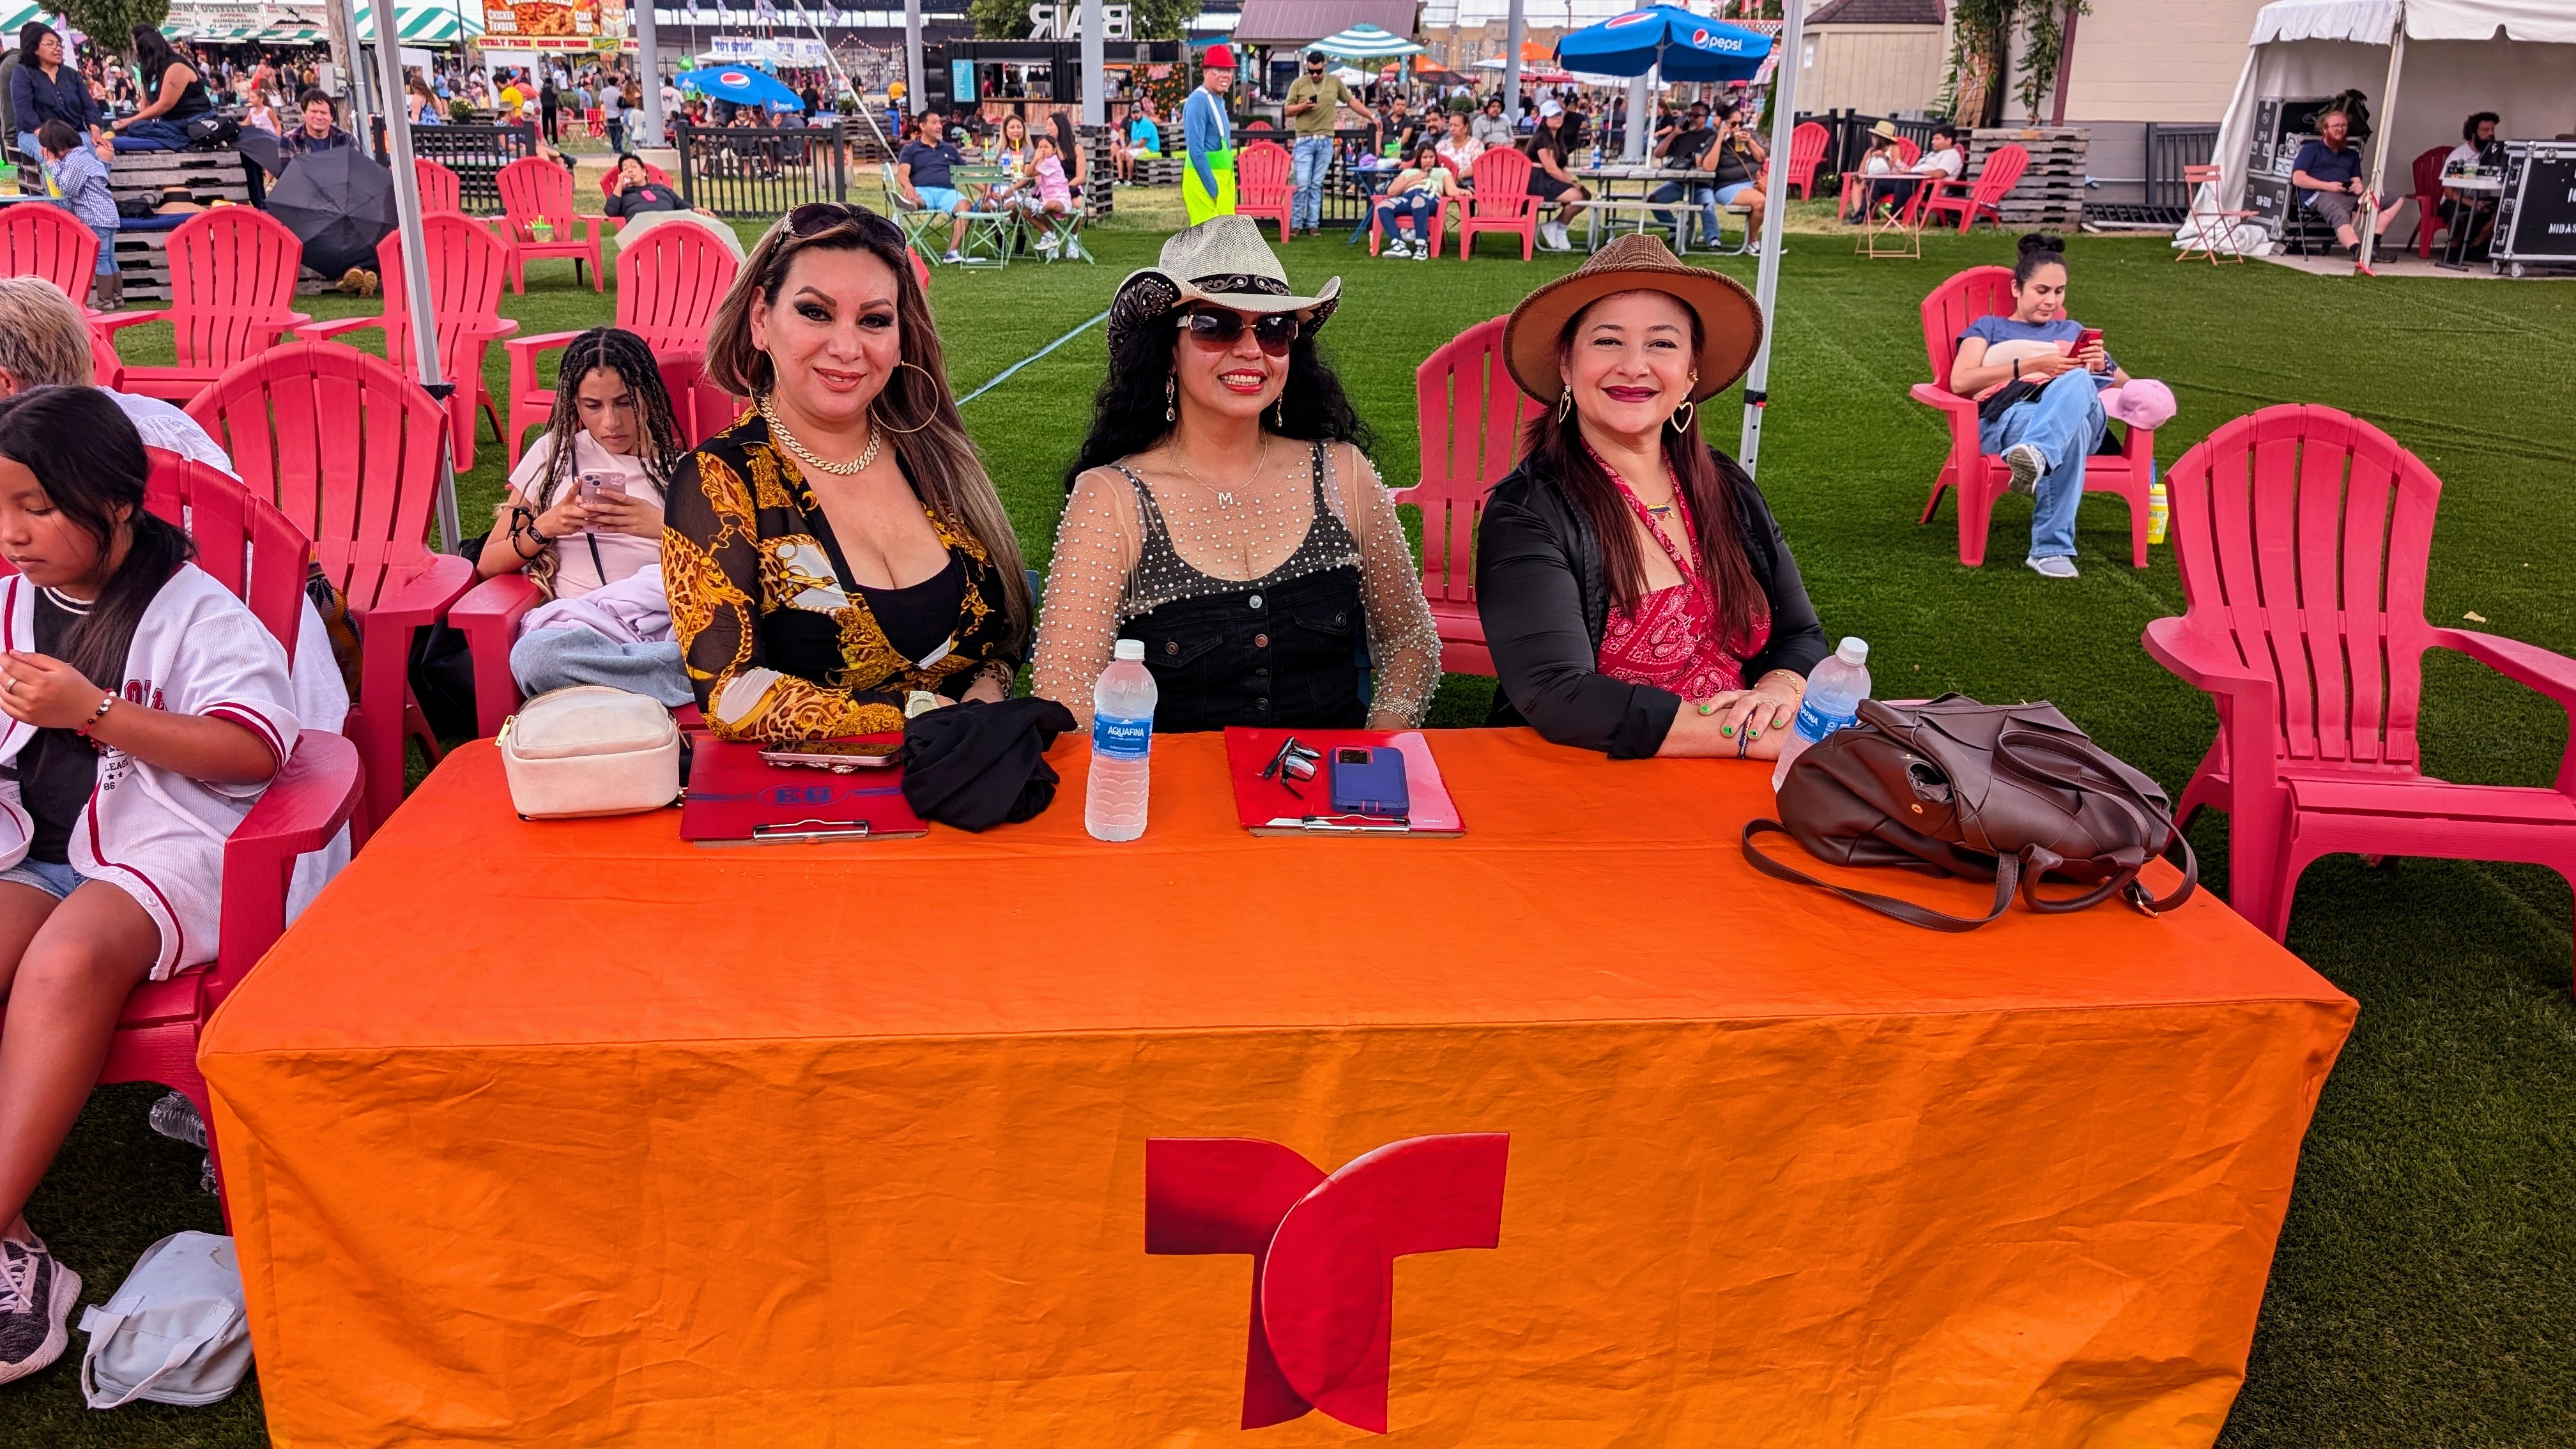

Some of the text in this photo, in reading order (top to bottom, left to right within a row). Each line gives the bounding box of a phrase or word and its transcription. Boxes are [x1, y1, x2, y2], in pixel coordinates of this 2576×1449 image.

[1709, 36, 1743, 52] pepsi
[1800, 705, 1819, 726] UAFINA
[1107, 726, 1145, 737] AQUAFINA
[103, 781, 116, 791] 86
